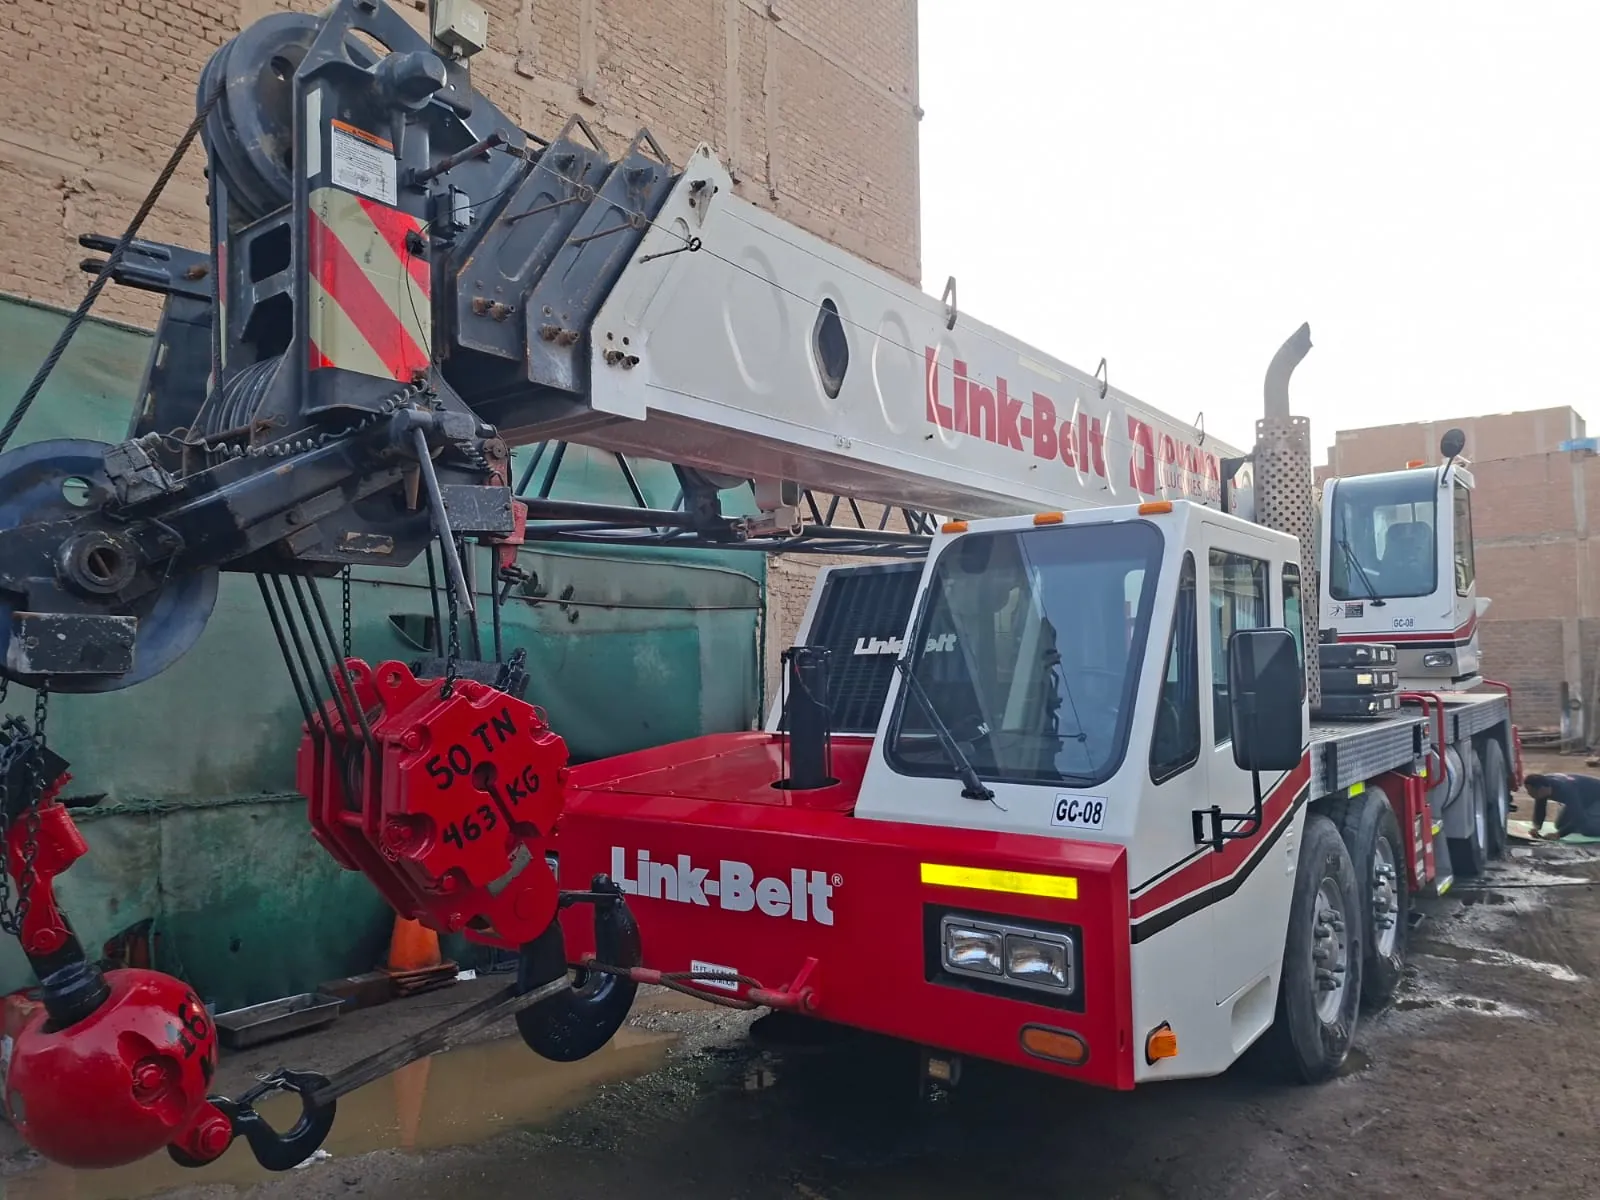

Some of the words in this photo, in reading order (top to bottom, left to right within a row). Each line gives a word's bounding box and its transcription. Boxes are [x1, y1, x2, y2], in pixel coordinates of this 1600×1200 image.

[925, 345, 1106, 478] Link-Belt
[1393, 618, 1414, 628] GC-08
[425, 744, 471, 790] 50
[471, 707, 518, 752] TN
[443, 804, 497, 849] 463
[505, 765, 541, 806] KG
[1056, 799, 1103, 825] GC-08
